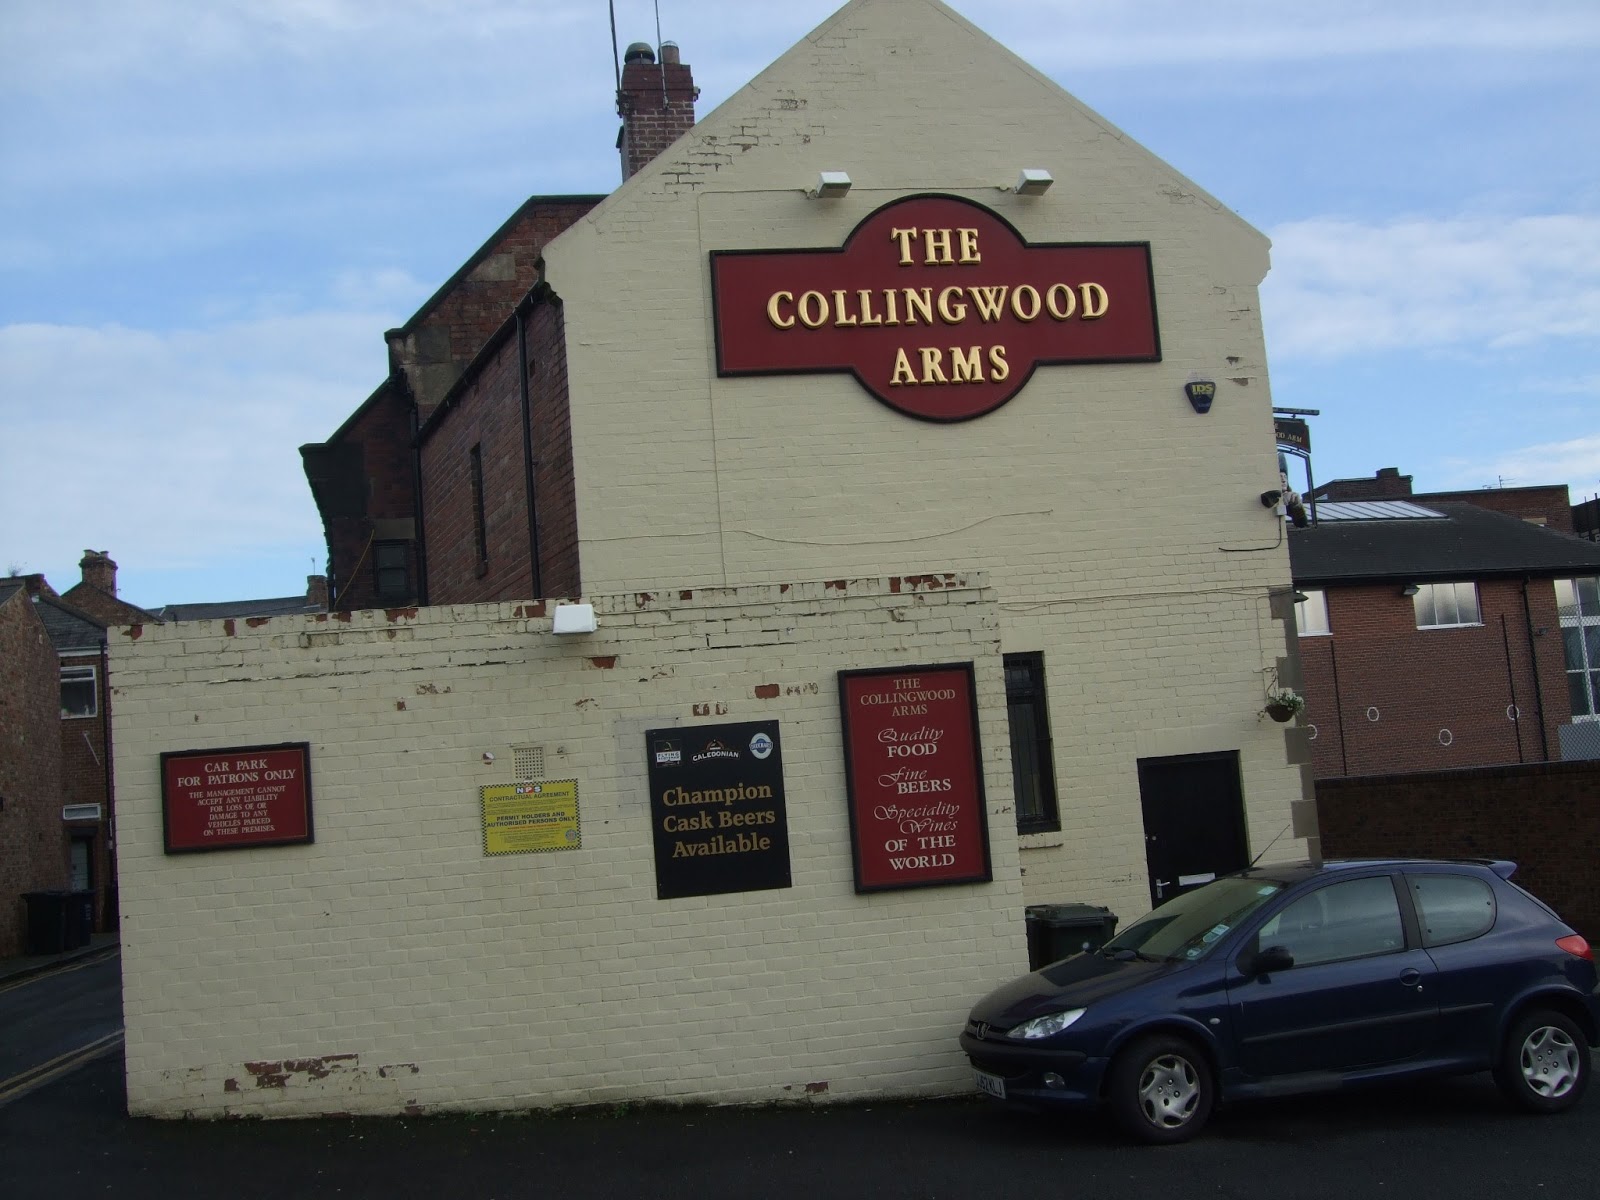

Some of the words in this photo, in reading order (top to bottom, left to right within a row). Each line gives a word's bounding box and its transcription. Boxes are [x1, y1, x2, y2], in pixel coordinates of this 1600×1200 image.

[891, 227, 982, 265] THE
[766, 282, 1110, 329] COLLINGWOOD
[889, 345, 1010, 386] ARMS
[893, 678, 921, 690] THE
[860, 689, 956, 706] COLLINGWOOD
[892, 704, 928, 717] ARMS
[878, 726, 944, 744] Quality
[692, 751, 739, 762] CALEDONIAN
[887, 743, 938, 758] FOOD
[204, 761, 229, 773] CAR
[237, 759, 268, 771] PARK
[177, 776, 201, 787] FOR
[208, 772, 259, 785] PATRONS
[264, 769, 296, 781] ONLY
[878, 766, 927, 787] Fine
[189, 791, 204, 799] THE
[207, 787, 254, 798] MANAGEMENT
[257, 785, 286, 794] CANNOT
[516, 785, 542, 794] NPS
[662, 782, 772, 806] Champion
[897, 778, 952, 795] BEERS
[197, 797, 222, 806] ACCEPT
[226, 796, 240, 804] ANY
[244, 793, 278, 802] LIABILITY
[490, 794, 532, 802] CONTRACTUAL
[534, 791, 569, 799] AGREEMENT
[209, 811, 237, 820] DAMAGE
[253, 809, 268, 817] ANY
[210, 805, 223, 813] FOR
[226, 804, 242, 812] LOSS
[496, 814, 519, 822] PERMIT
[521, 811, 550, 819] HOLDERS
[873, 801, 960, 823] Speciality
[208, 819, 240, 828] VEHICLES
[243, 817, 271, 826] PARKED
[487, 819, 527, 828] AUTHORISED
[528, 817, 557, 825] PERSONS
[663, 811, 714, 833] Cask
[718, 810, 776, 828] Beers
[900, 817, 958, 835] Wines
[217, 827, 238, 836] THESE
[672, 832, 771, 858] Available
[885, 839, 908, 853] OF
[918, 834, 956, 850] THE
[889, 853, 955, 870] WORLD
